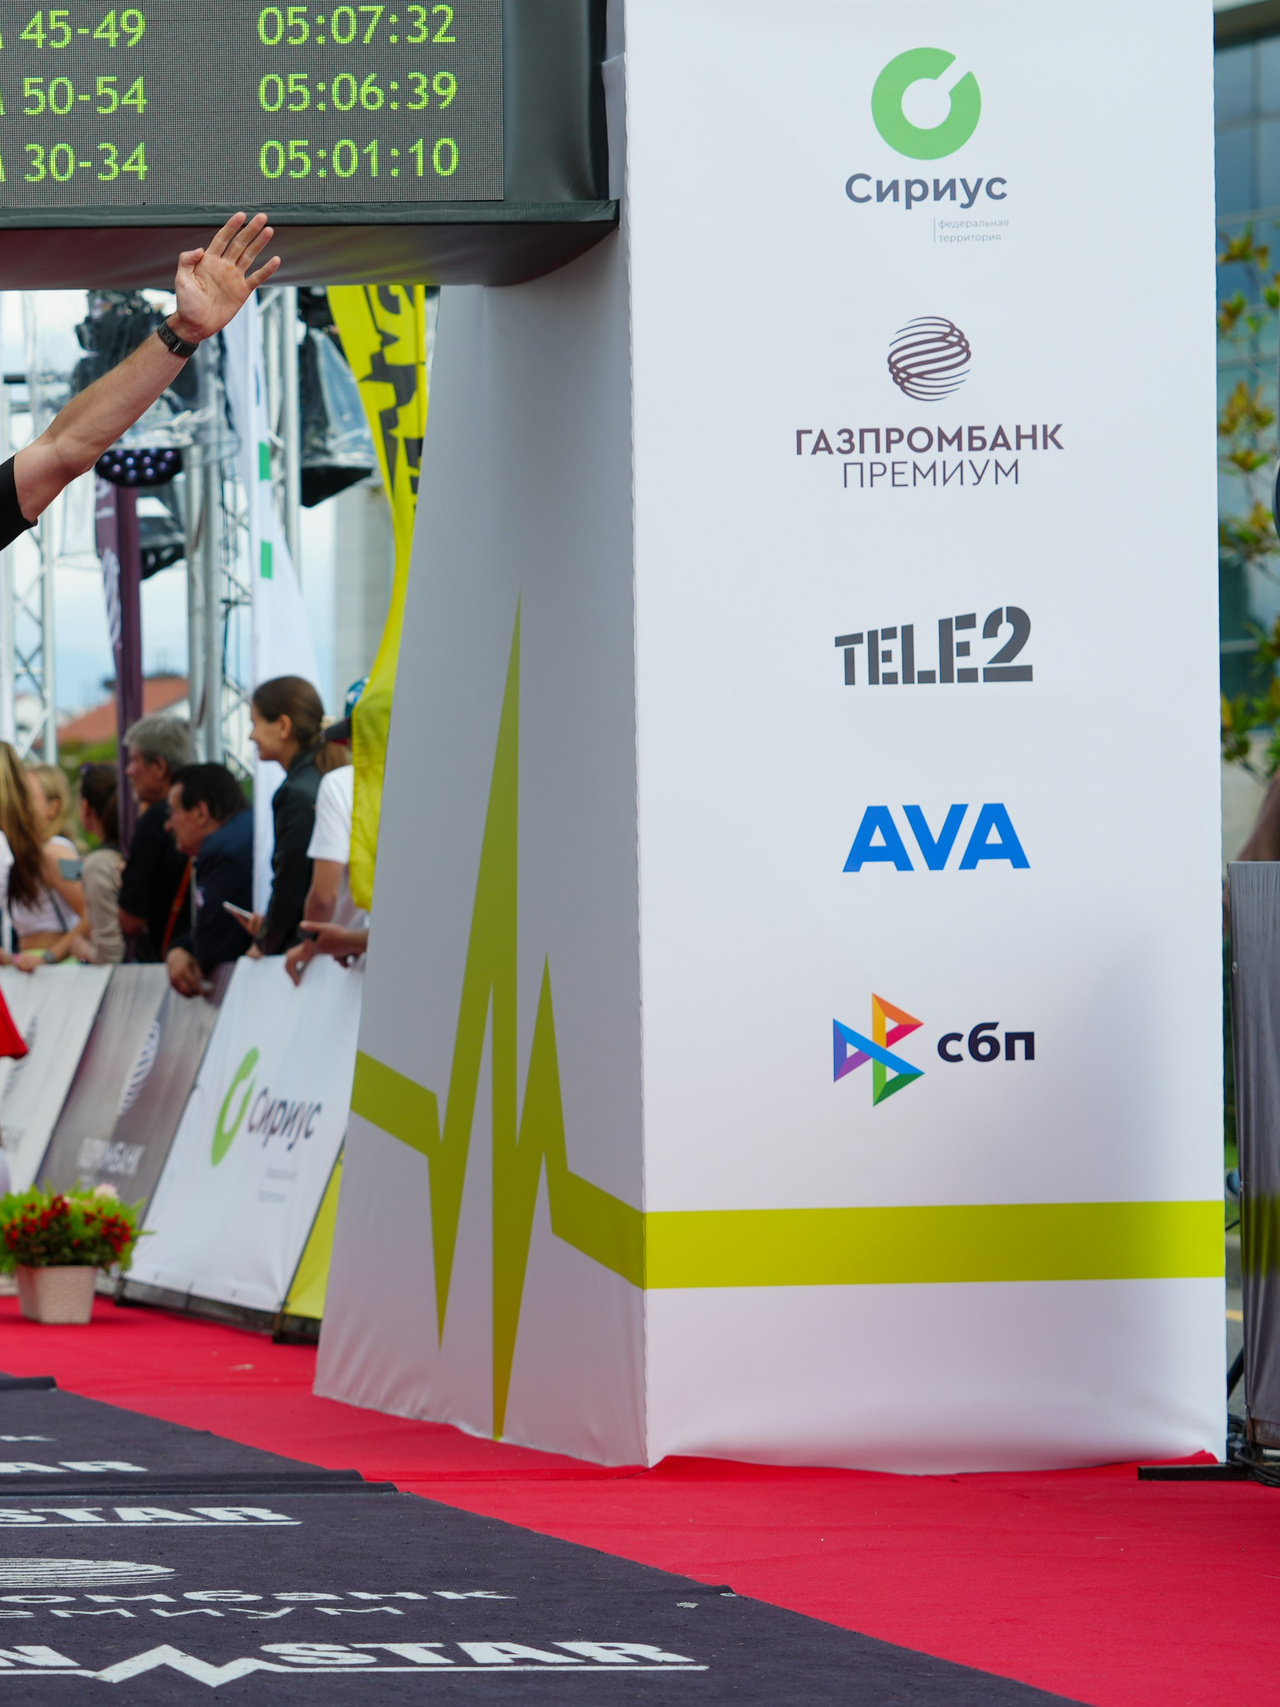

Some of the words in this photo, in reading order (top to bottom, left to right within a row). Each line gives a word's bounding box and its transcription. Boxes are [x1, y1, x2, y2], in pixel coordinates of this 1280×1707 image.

[20, 7, 147, 49] 45-49
[257, 4, 457, 46] 05:07:32
[22, 75, 148, 115] 50-54
[258, 71, 458, 112] 05:06:39
[24, 141, 149, 182] 30-34
[260, 137, 459, 180] 05:01:10
[845, 173, 1008, 210] Сириус
[938, 219, 1010, 230] федеральная
[938, 234, 1001, 243] территория
[795, 424, 1065, 456] ГАЗПРОМБАНК
[843, 459, 1020, 489] ПРЕМИУМ
[834, 605, 1034, 686] TELE2
[842, 803, 1031, 873] AVA
[936, 1021, 1036, 1063] сбп
[248, 1086, 322, 1151] Сириус
[260, 1641, 696, 1665] STAR
